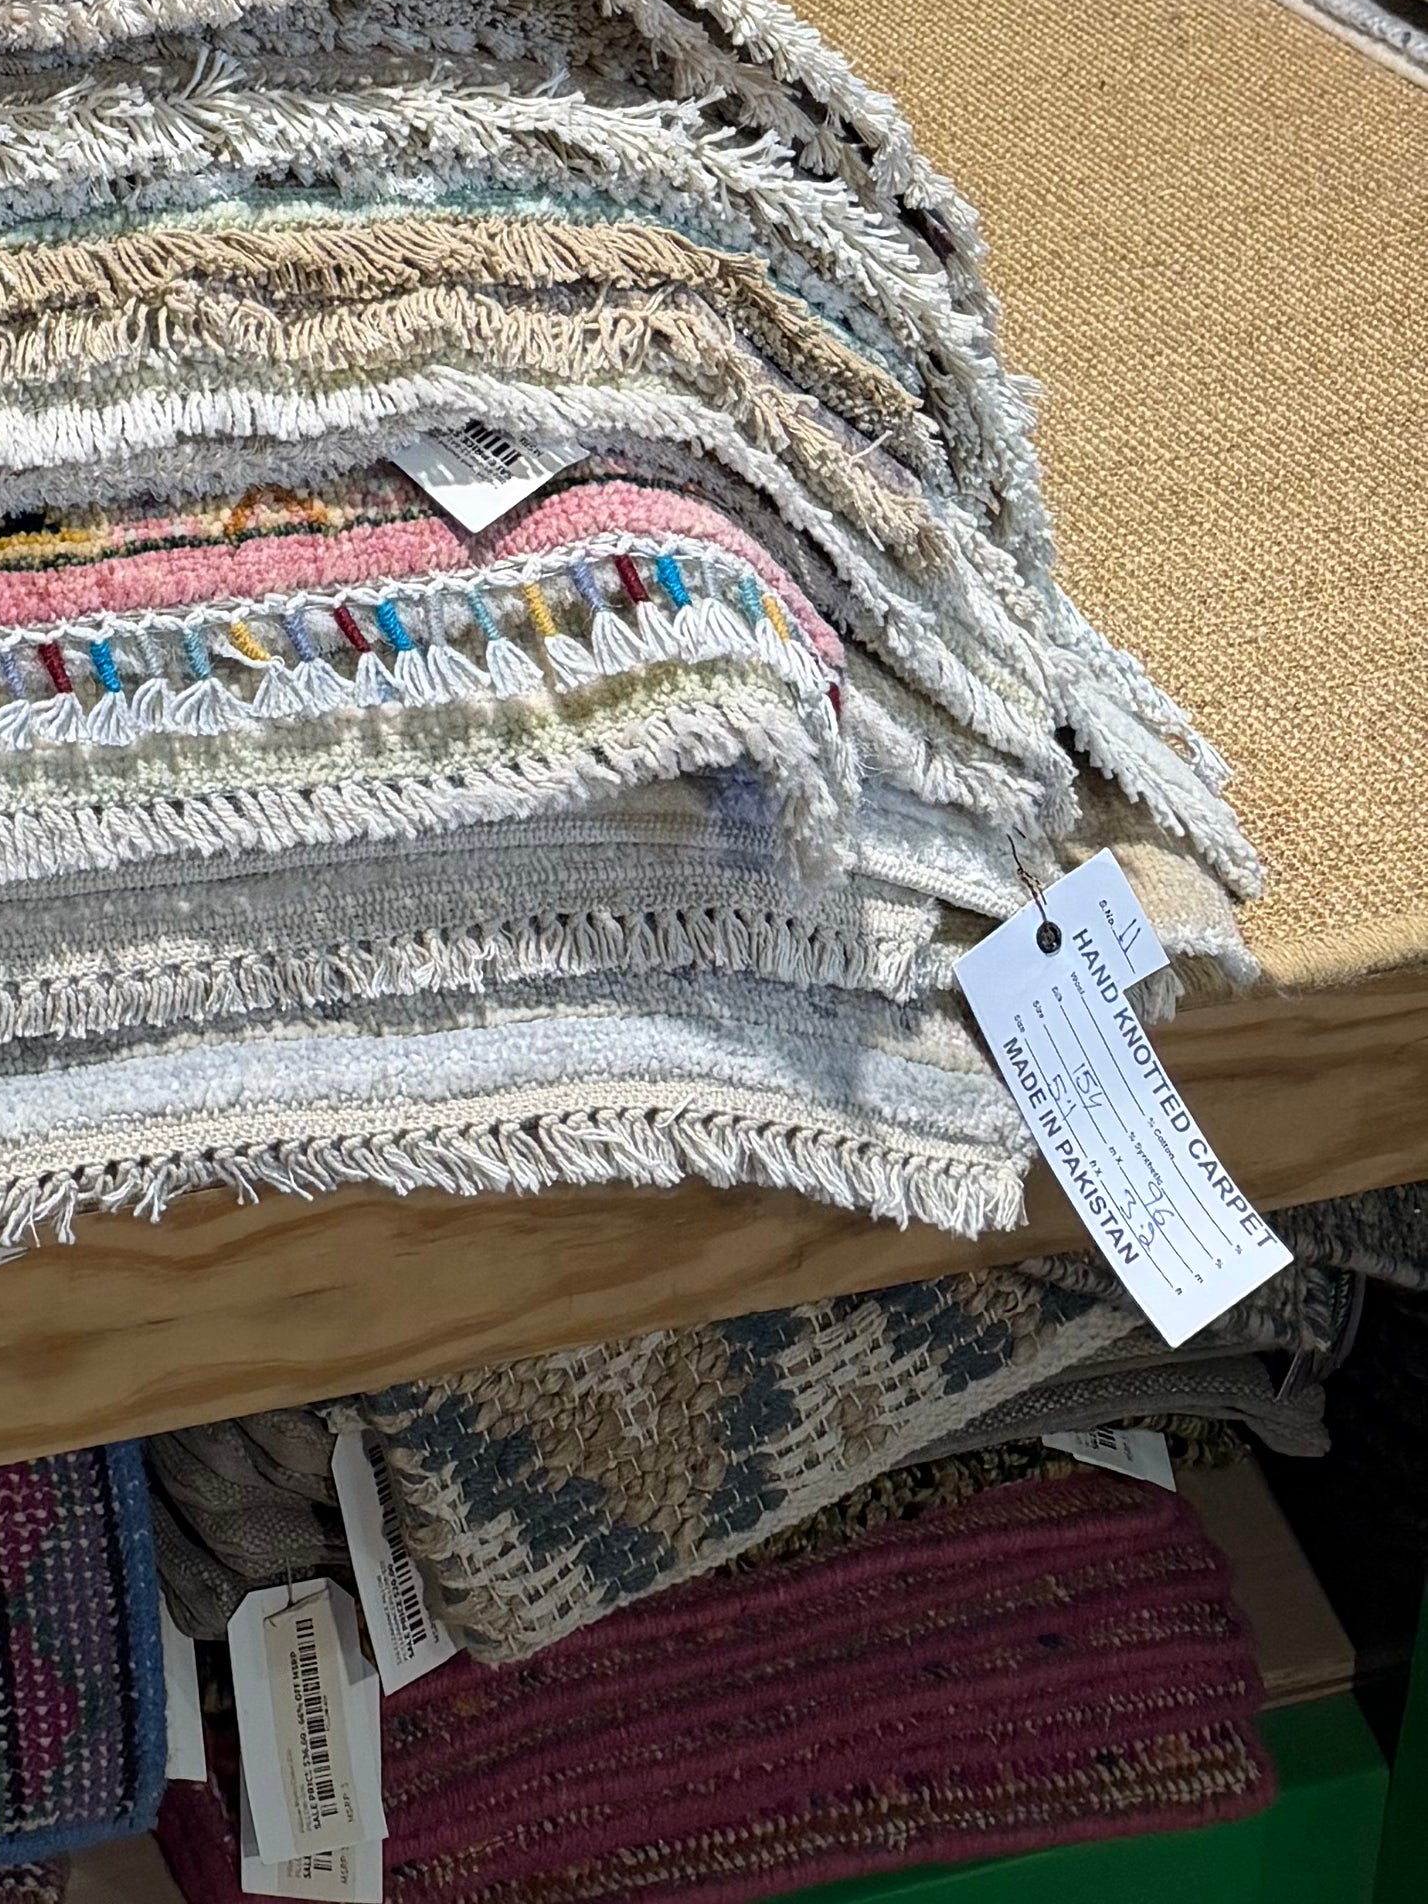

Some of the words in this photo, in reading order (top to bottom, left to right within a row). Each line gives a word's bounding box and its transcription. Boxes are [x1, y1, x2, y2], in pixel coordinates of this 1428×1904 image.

[1070, 928, 1121, 1005] HAND
[1111, 1006, 1193, 1135] KNOTTED
[1188, 1137, 1277, 1248] CARPET
[1001, 1036, 1048, 1110] MADE
[1038, 1109, 1062, 1137] IN
[1053, 1139, 1141, 1265] PAKISTAN
[1151, 1126, 1176, 1161] Cotton
[1143, 1179, 1176, 1229] 96
[396, 1599, 407, 1631] PRICE
[289, 1650, 300, 1679] MSRP
[293, 1680, 301, 1701] OFF
[303, 1768, 316, 1800] PRICE
[309, 1803, 321, 1829] SALE
